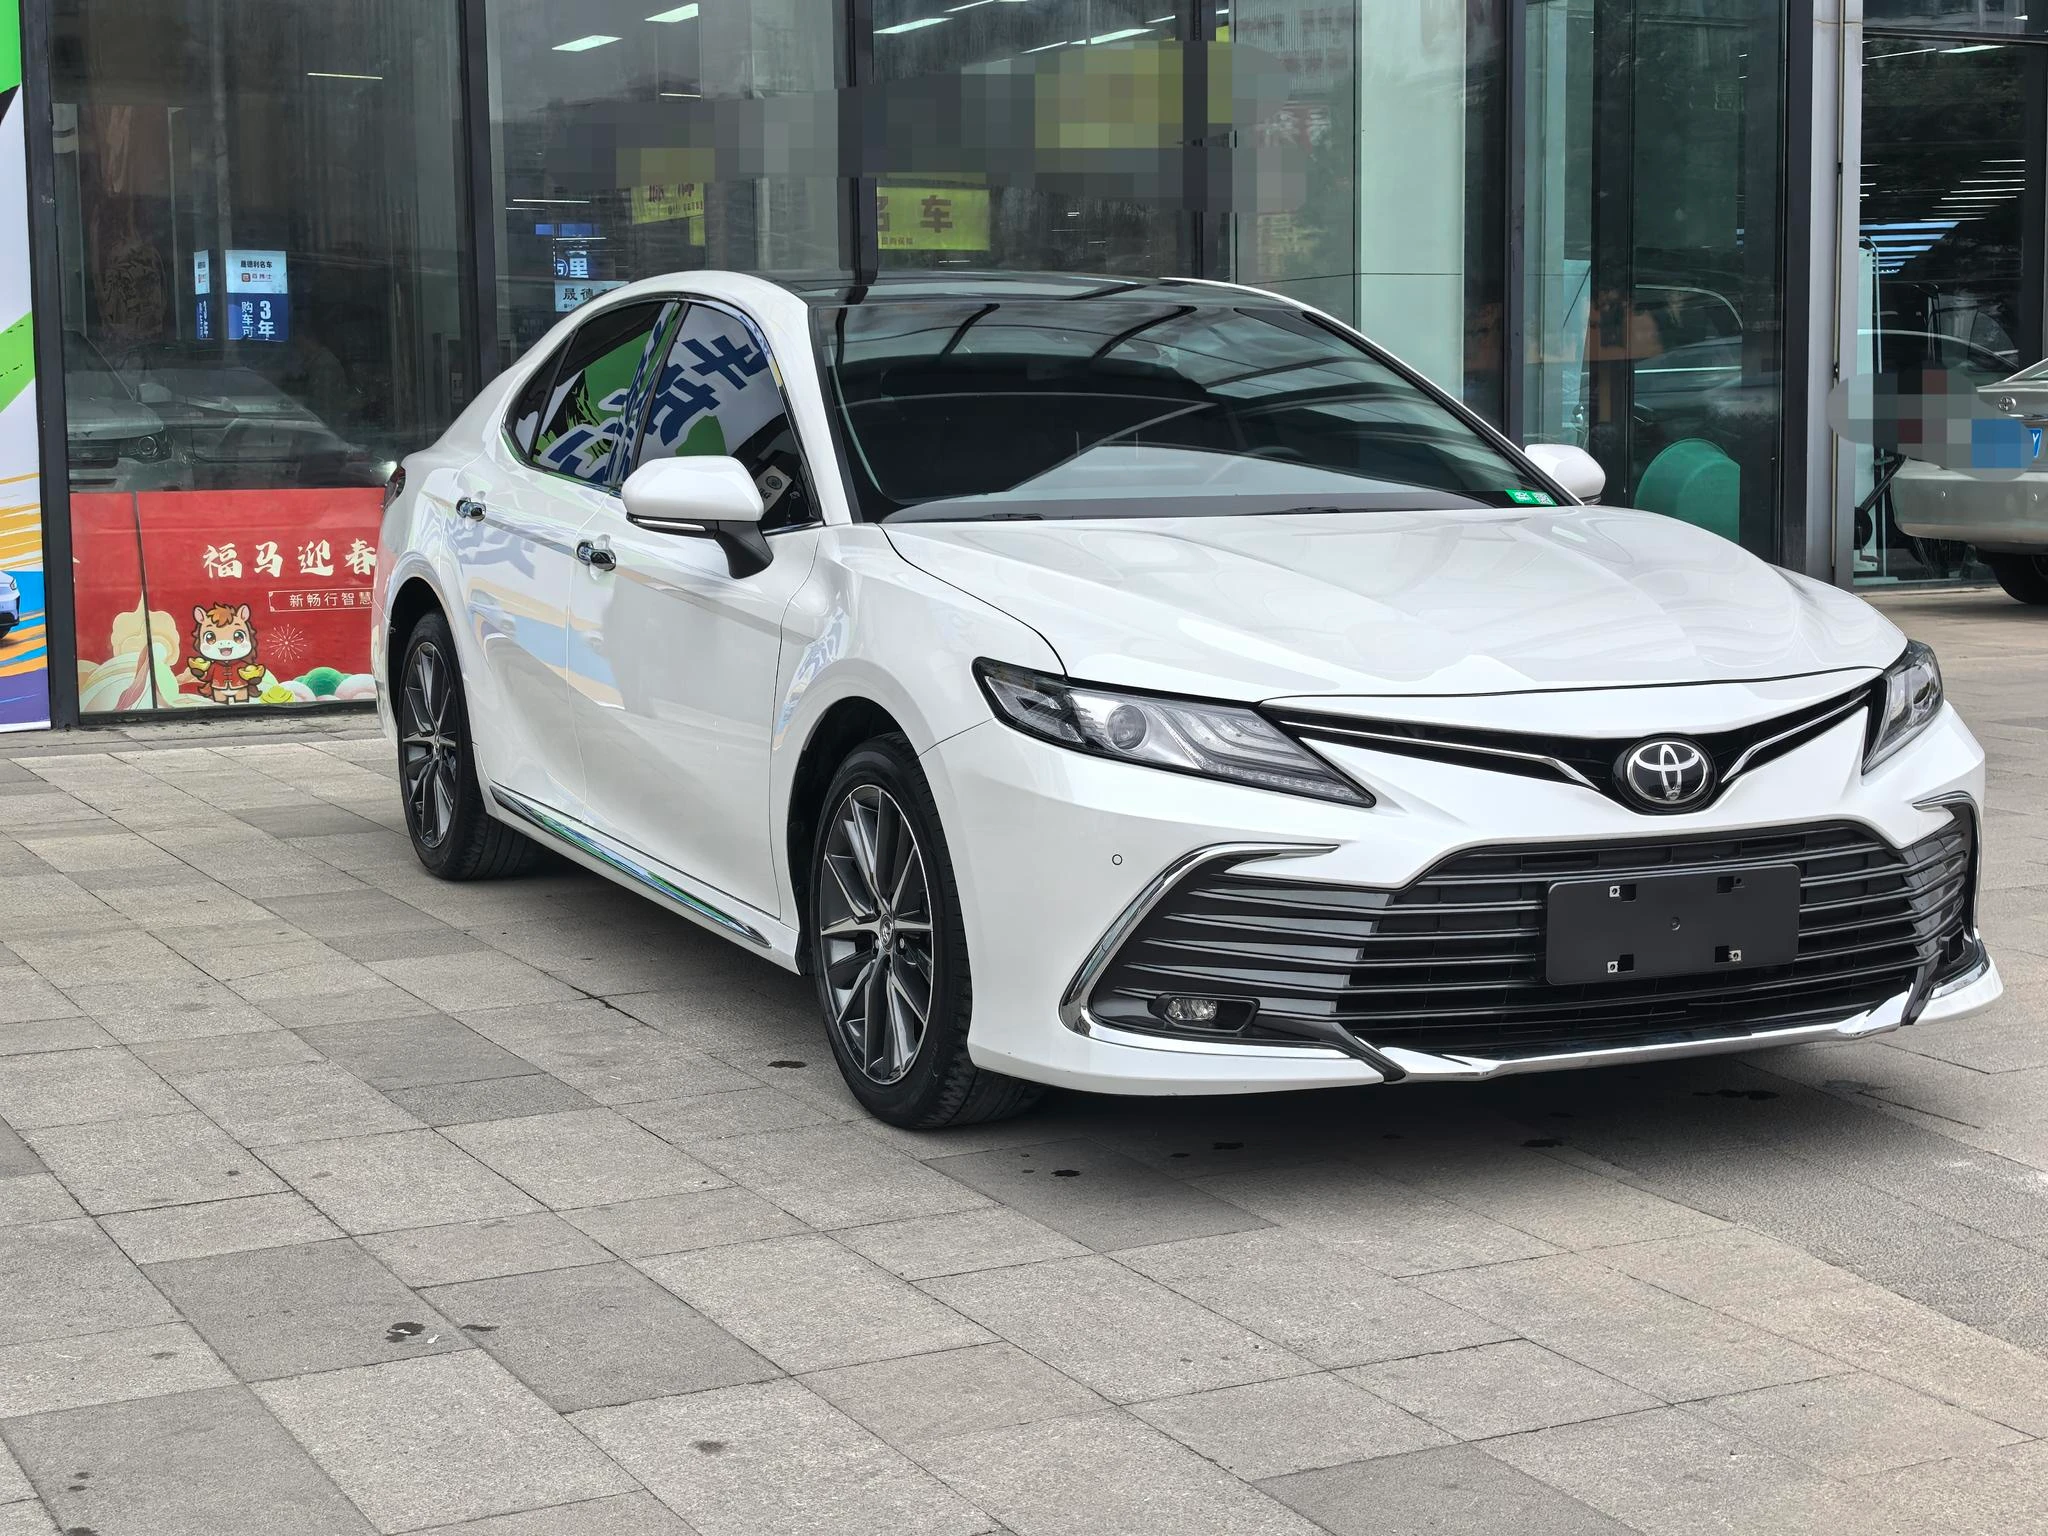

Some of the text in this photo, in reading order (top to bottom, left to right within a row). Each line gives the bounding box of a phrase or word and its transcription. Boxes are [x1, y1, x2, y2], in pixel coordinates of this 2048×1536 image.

[562, 287, 606, 301] 晟德
[241, 301, 255, 338] 购车可
[258, 300, 276, 338] 3年
[202, 537, 377, 579] 福马迎春
[289, 591, 373, 609] 新畅行智慧
